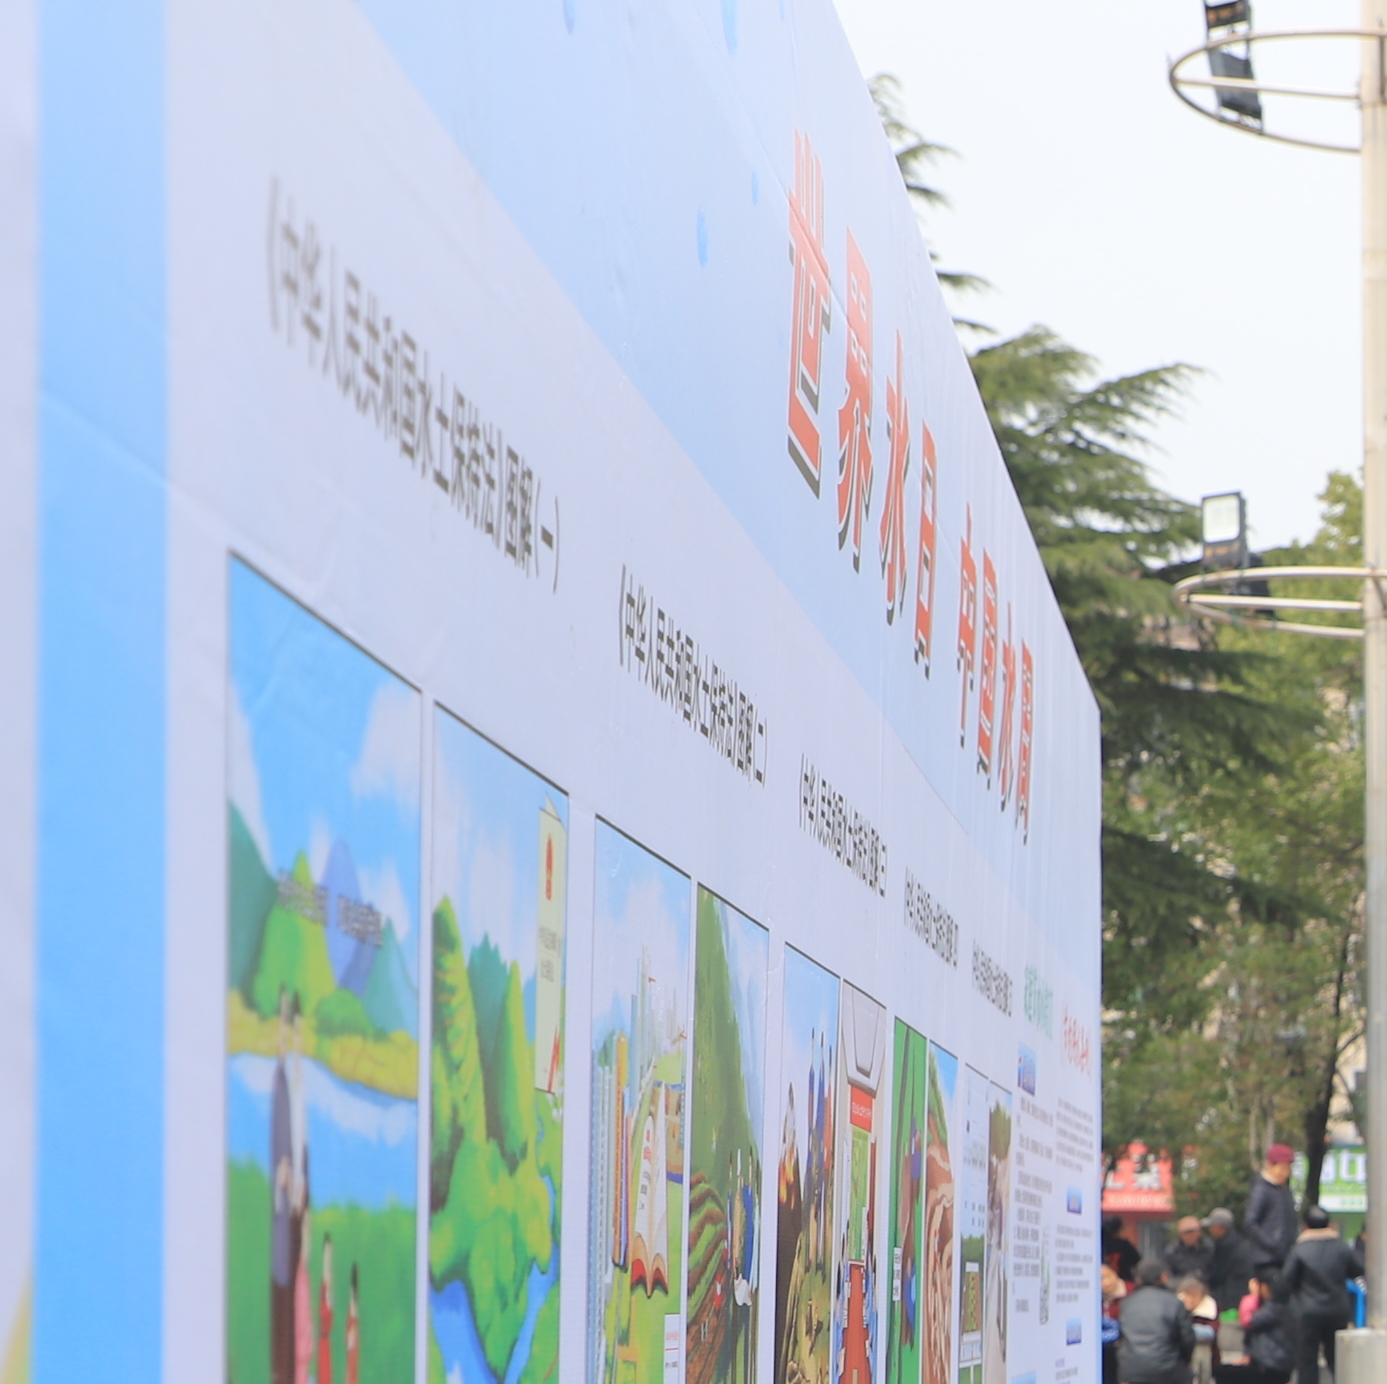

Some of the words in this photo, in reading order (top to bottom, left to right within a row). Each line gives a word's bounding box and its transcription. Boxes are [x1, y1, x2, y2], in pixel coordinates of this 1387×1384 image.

[787, 128, 937, 680] 世界水日
[956, 503, 1034, 846] 中国水周
